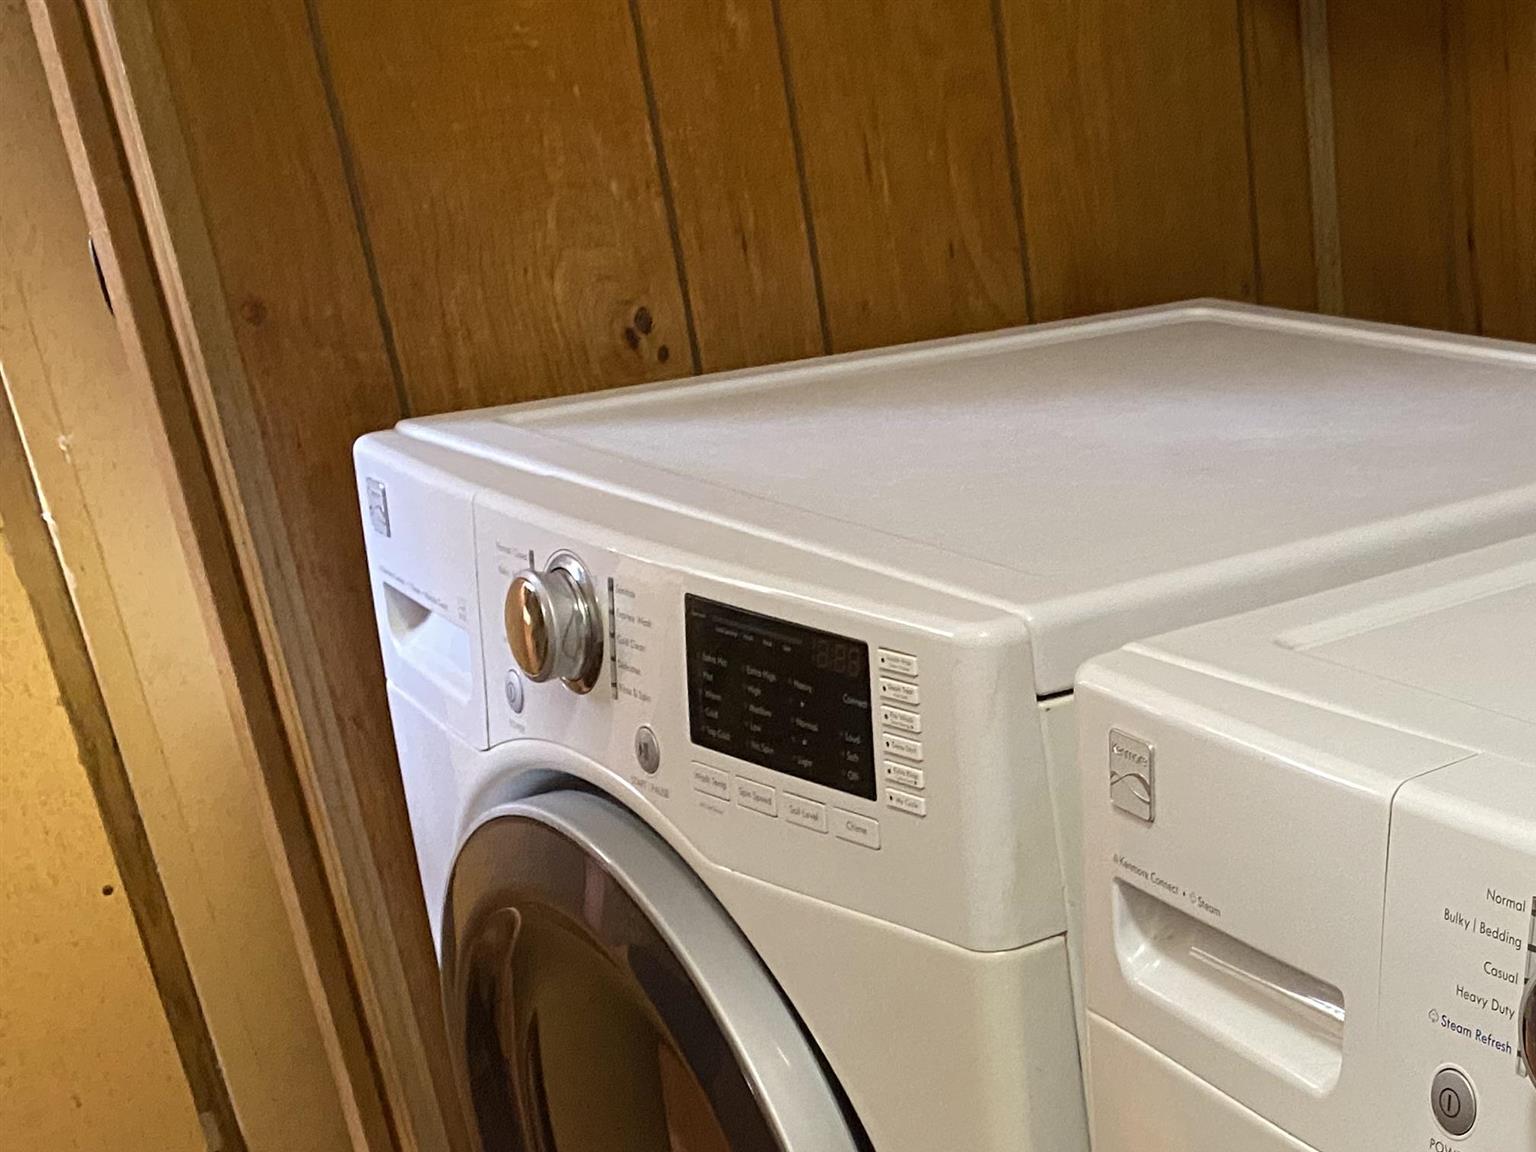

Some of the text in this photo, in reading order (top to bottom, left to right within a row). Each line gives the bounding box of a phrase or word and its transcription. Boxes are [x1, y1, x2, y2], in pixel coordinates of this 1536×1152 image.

[1486, 888, 1526, 912] Normal
[1444, 908, 1522, 950] Bulky Bedding
[1483, 961, 1519, 984] Casual
[1456, 984, 1515, 1020] Heavy Duty
[1441, 1015, 1512, 1054] Steam Refresh
